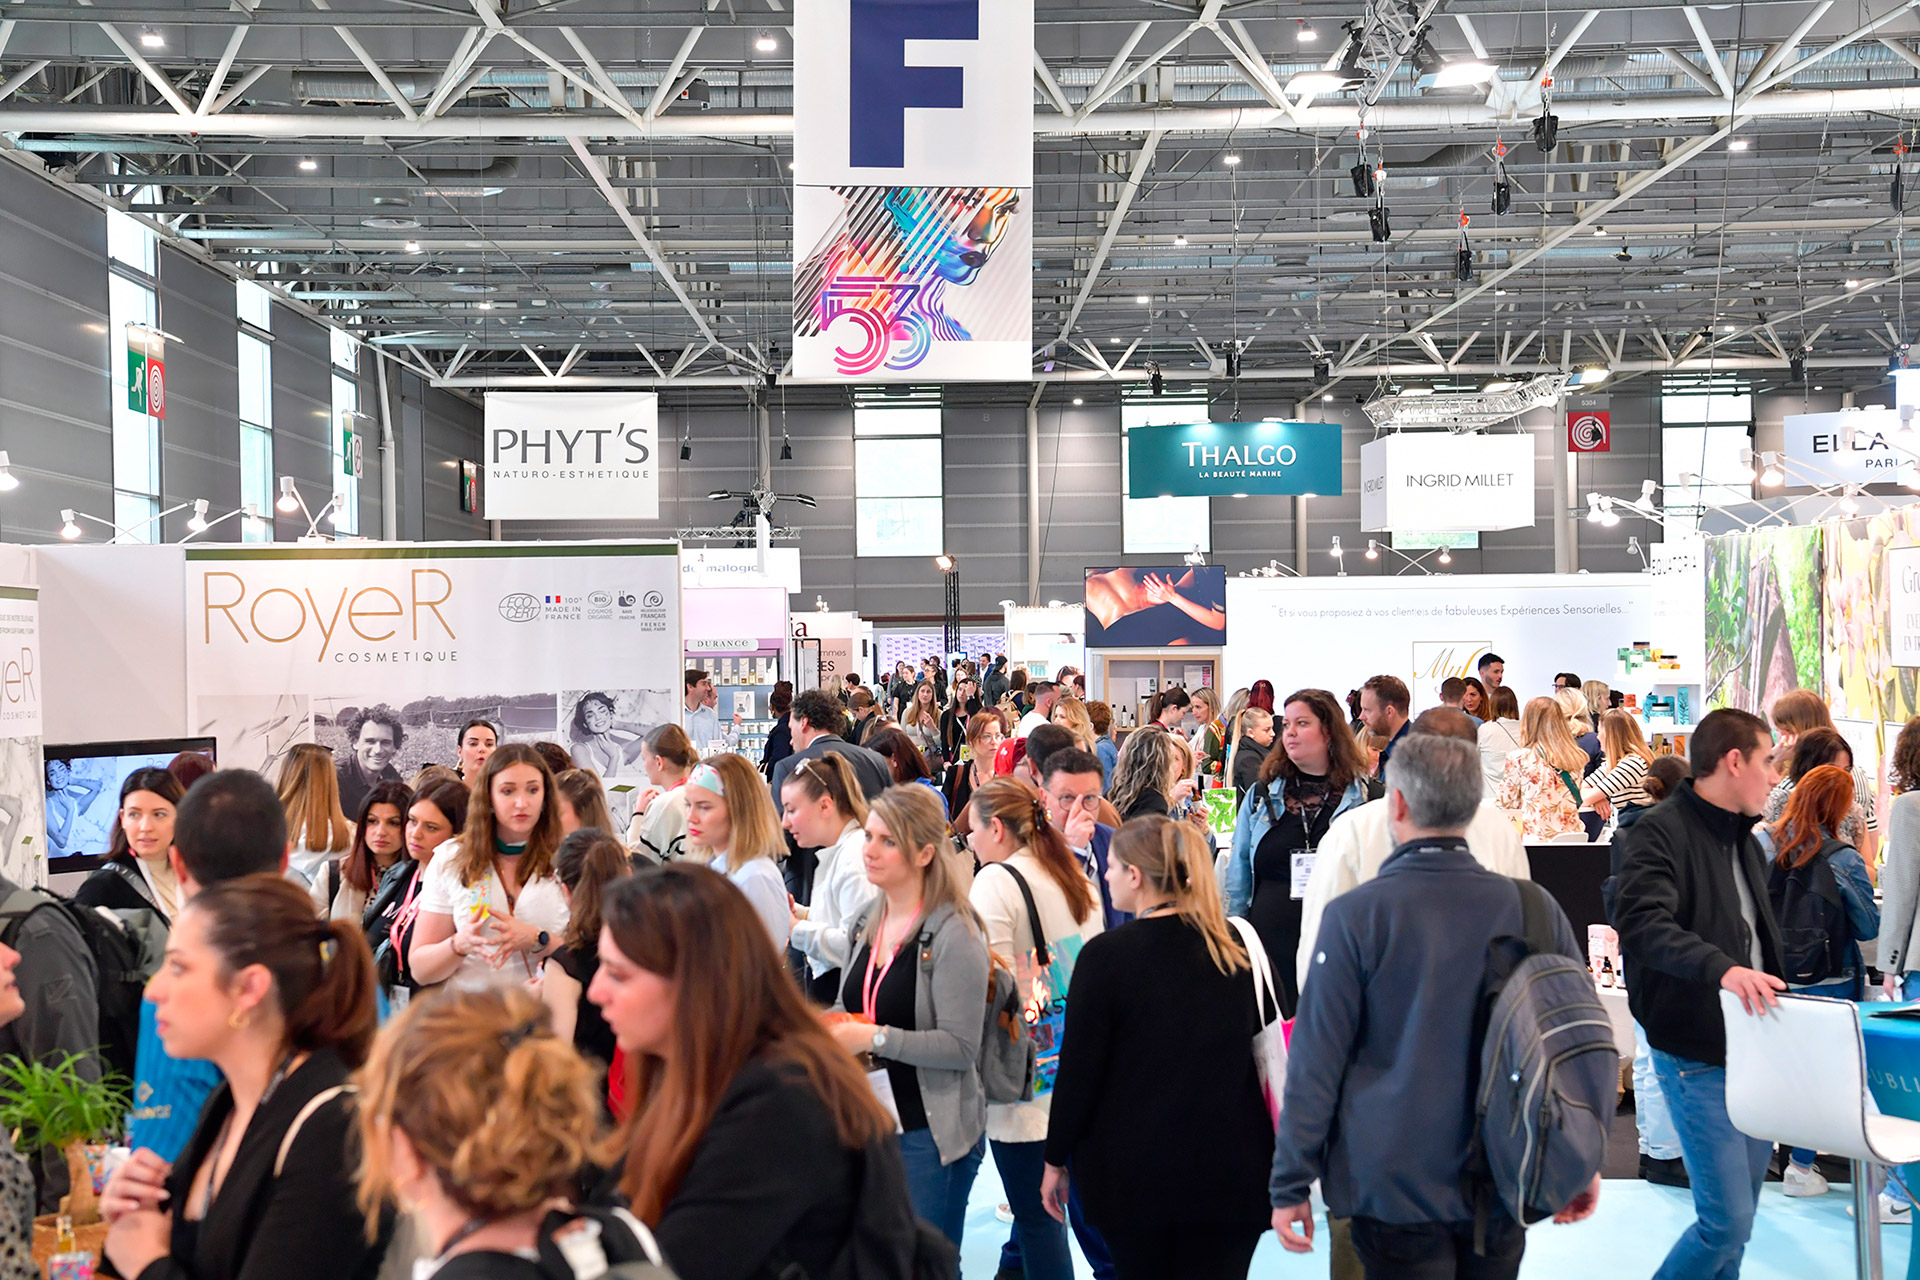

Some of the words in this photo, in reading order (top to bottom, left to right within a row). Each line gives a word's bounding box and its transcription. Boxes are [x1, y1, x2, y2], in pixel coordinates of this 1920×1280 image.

[850, 0, 979, 168] F
[493, 423, 650, 464] PHYT'S
[1181, 441, 1297, 467] THALGO
[493, 470, 649, 479] NATURO-ESTHETIQUE
[1213, 470, 1246, 478] BEAUTÉ
[1249, 470, 1282, 478] MARINE
[1407, 474, 1461, 487] INGRID
[1465, 473, 1514, 487] MILLET
[507, 596, 533, 608] ECO
[506, 607, 536, 619] CERT
[1297, 609, 1318, 617] vous
[1320, 608, 1363, 619] proposiez
[1366, 607, 1372, 617] à
[1374, 609, 1390, 617] vos
[1431, 606, 1443, 616] de
[1445, 605, 1498, 616] fabuleuses
[1500, 604, 1560, 618] Expériences
[335, 651, 458, 663] COSMETIQUE
